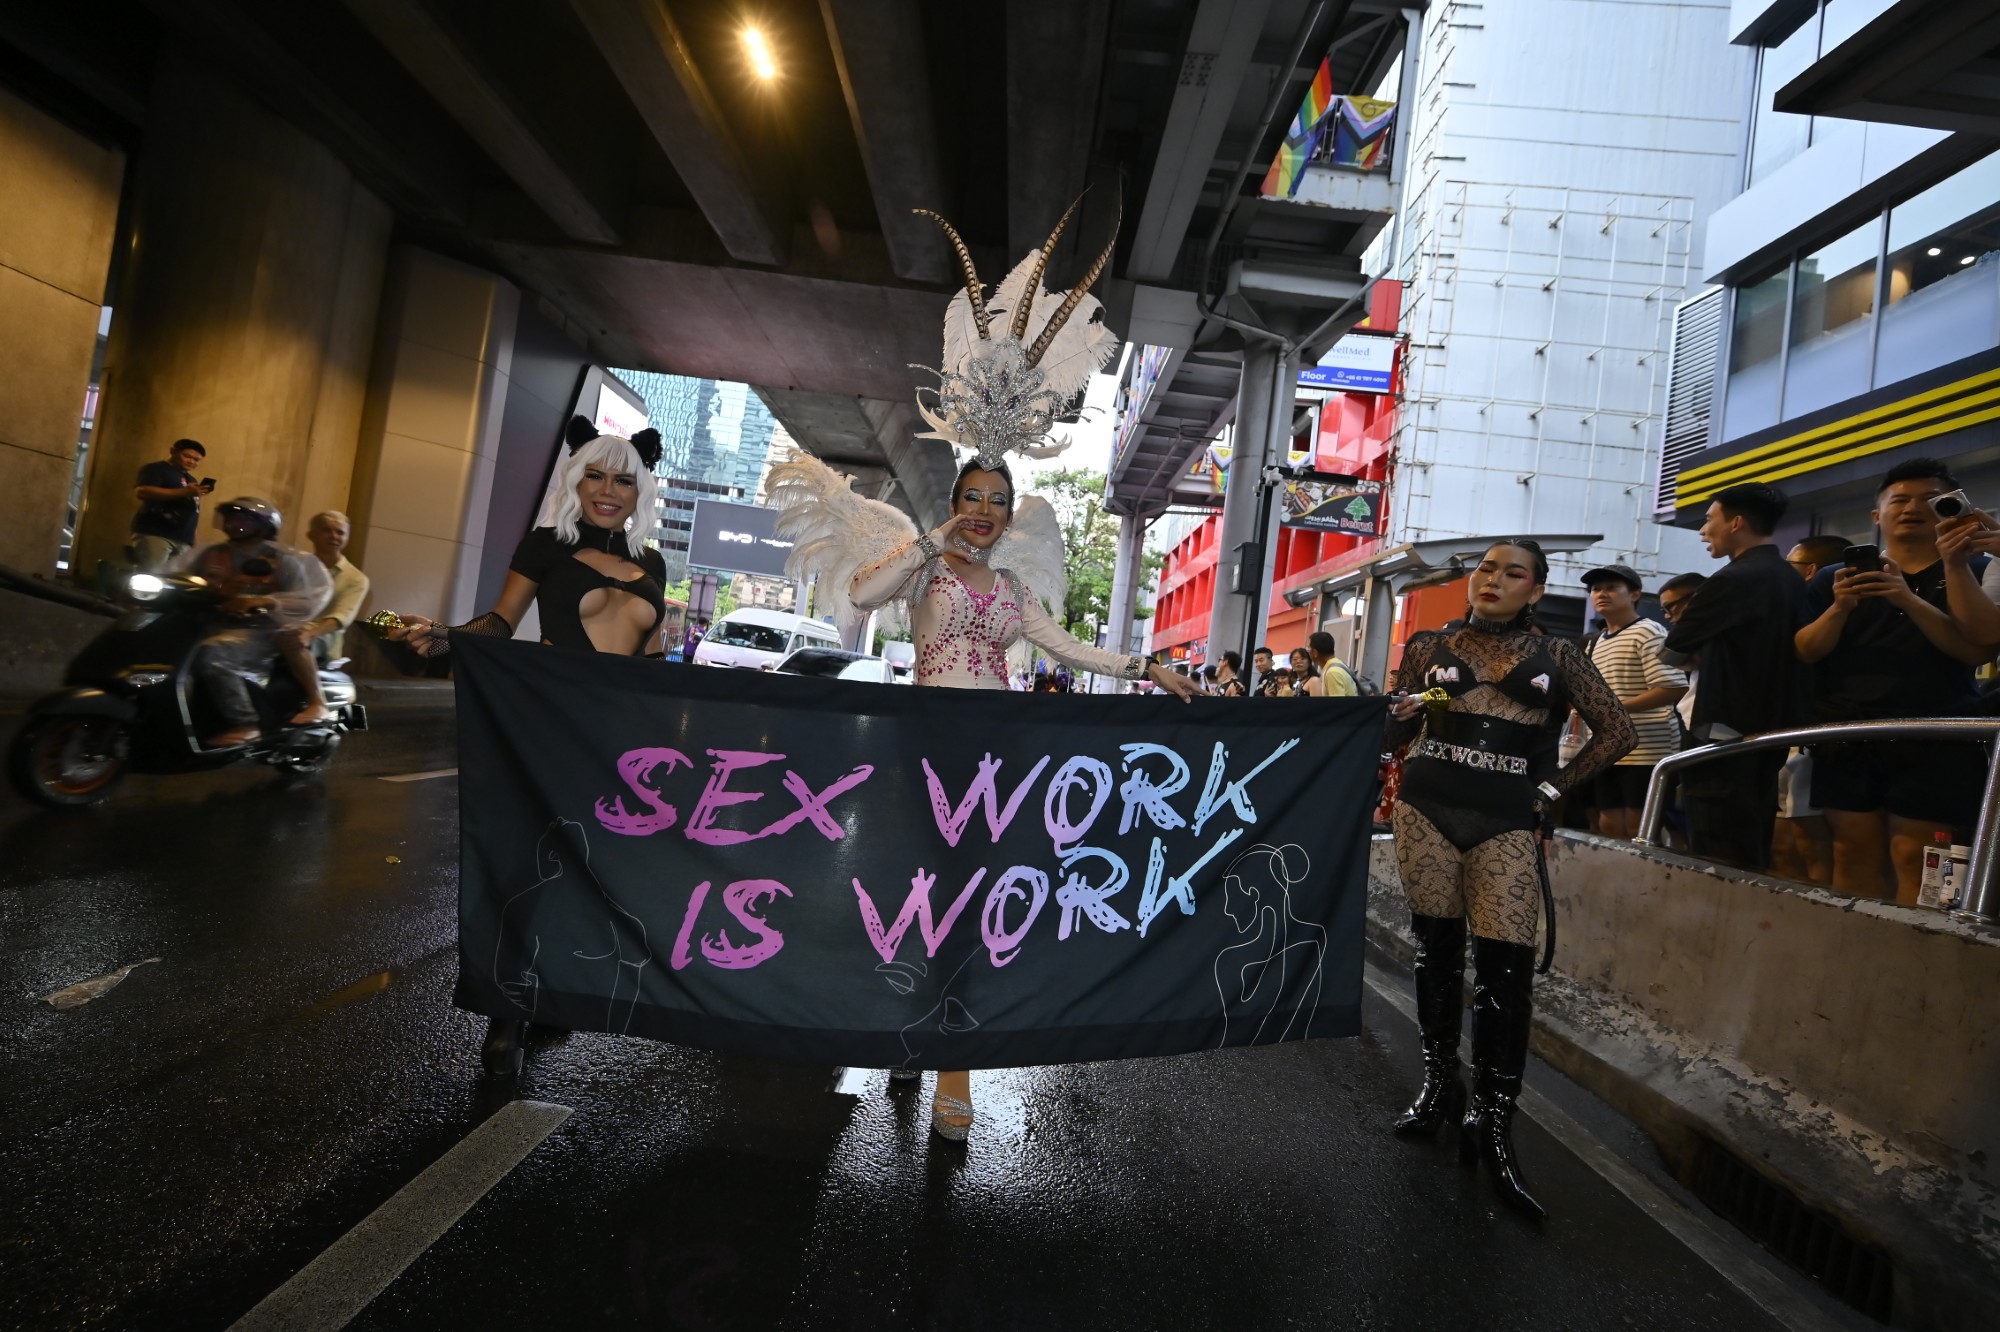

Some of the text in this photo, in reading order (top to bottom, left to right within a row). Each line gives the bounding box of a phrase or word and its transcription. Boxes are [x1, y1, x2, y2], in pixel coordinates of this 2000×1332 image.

[1301, 371, 1326, 380] Floor
[1340, 518, 1374, 531] Beirut
[1424, 664, 1550, 694] I'M A
[594, 737, 1300, 857] SEX WORK
[670, 828, 1243, 970] IS WORK
